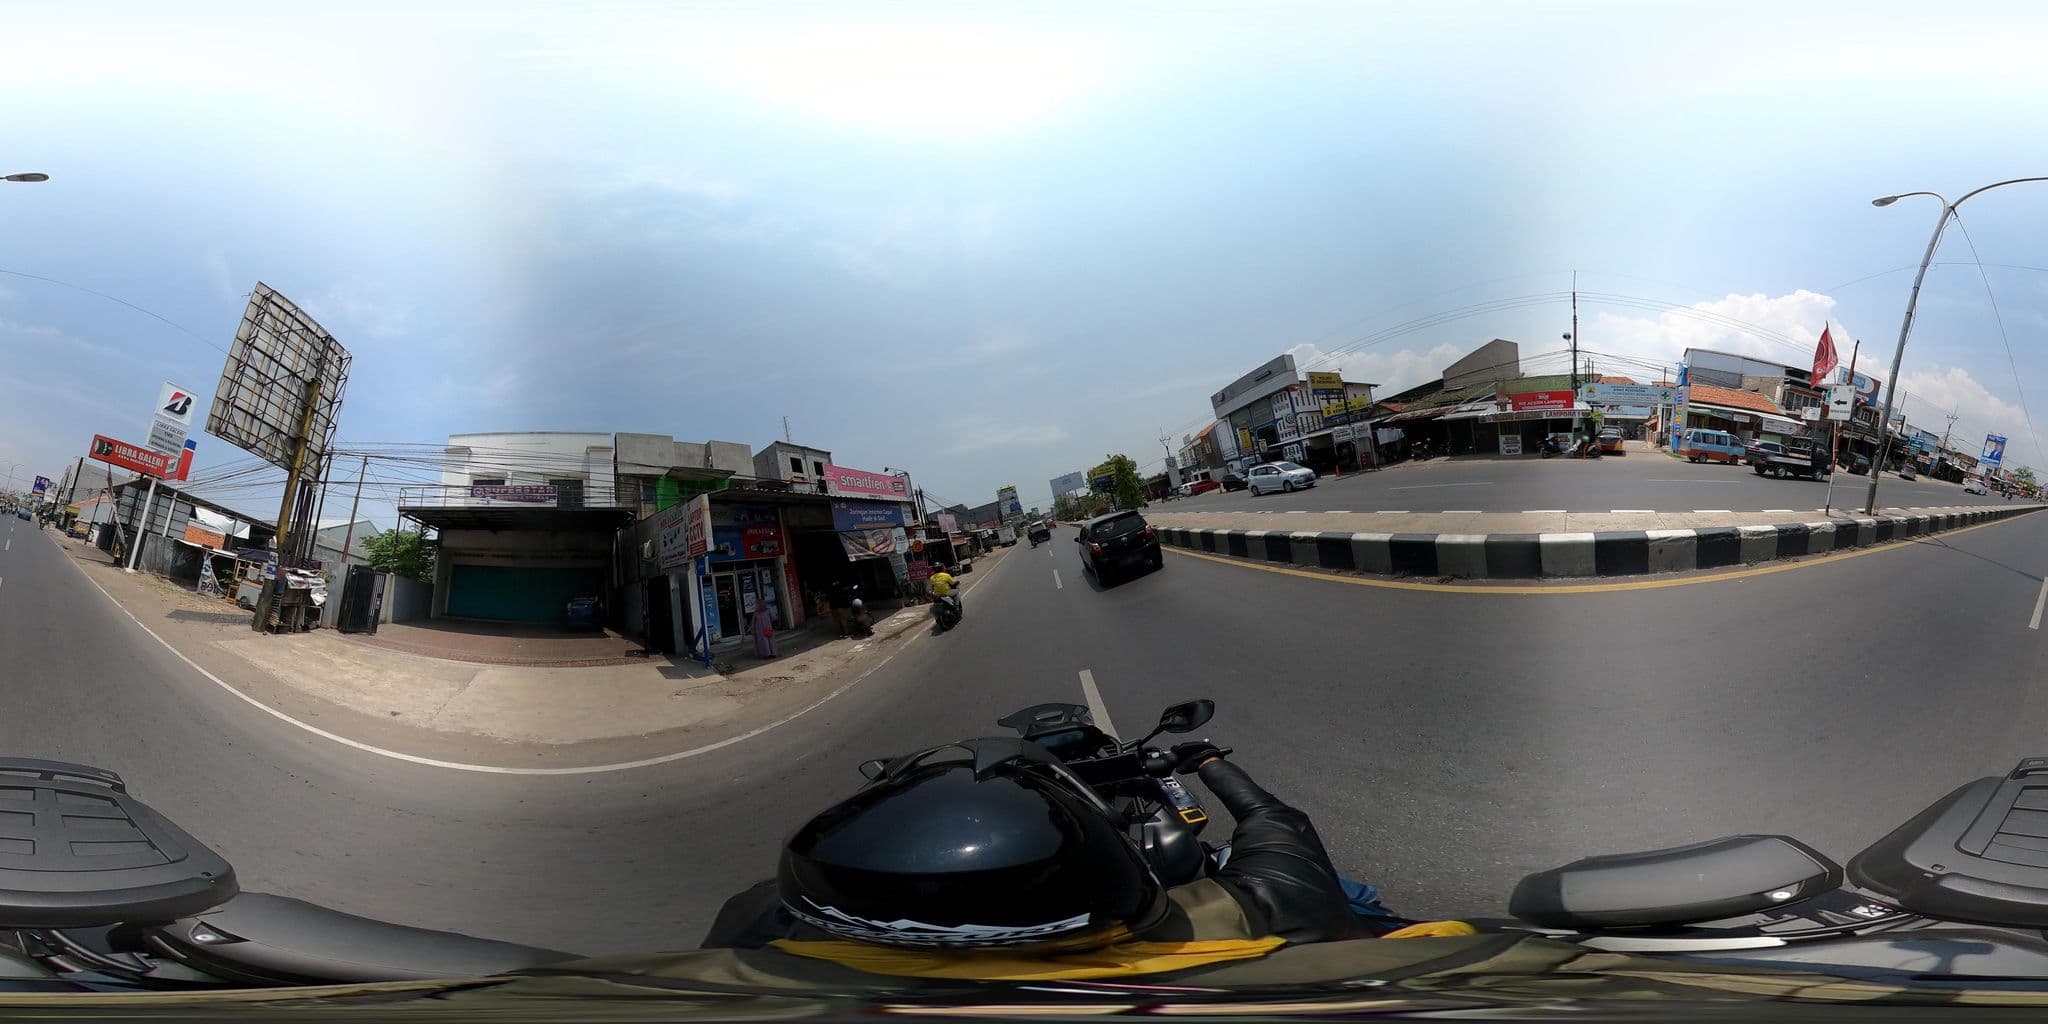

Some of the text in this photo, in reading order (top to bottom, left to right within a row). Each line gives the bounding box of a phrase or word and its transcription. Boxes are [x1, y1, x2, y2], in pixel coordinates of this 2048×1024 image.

[114, 444, 137, 458] LIBRA
[138, 452, 165, 468] GALERI
[840, 475, 885, 490] smartfren
[689, 520, 704, 541] CCTV
